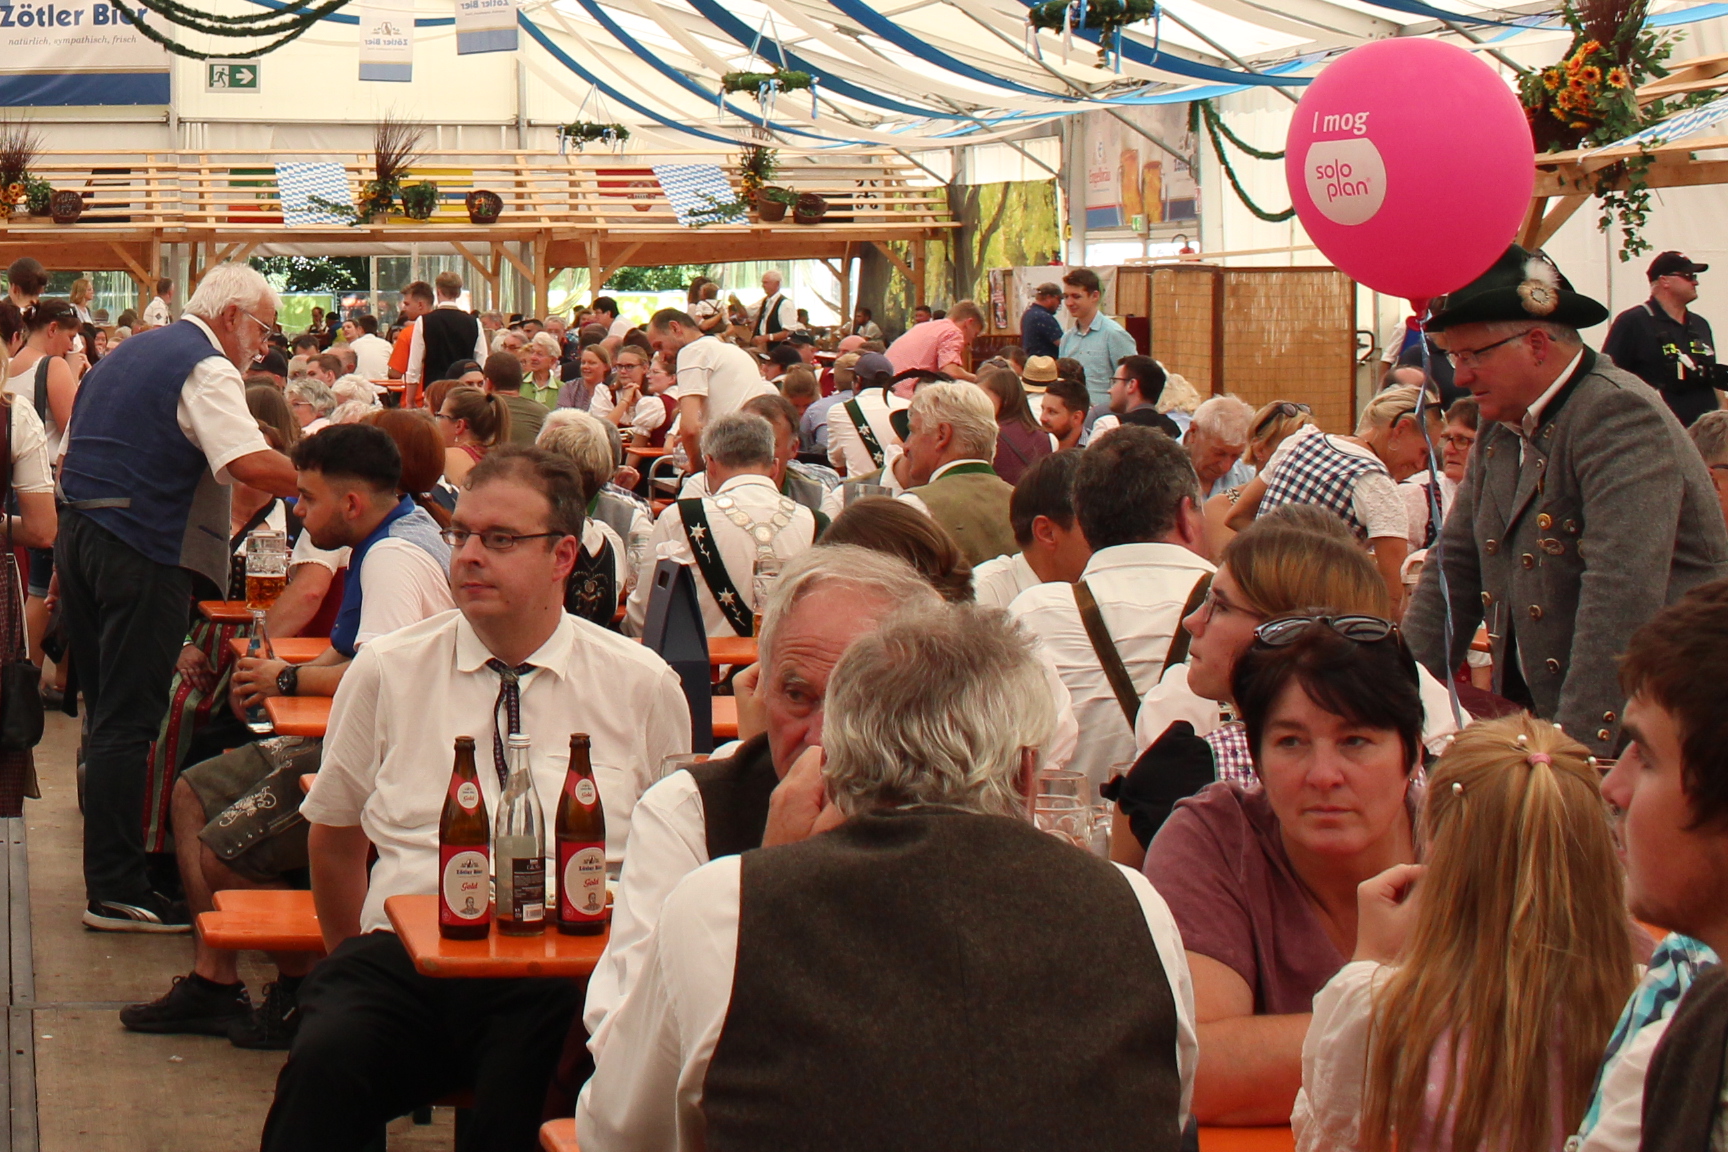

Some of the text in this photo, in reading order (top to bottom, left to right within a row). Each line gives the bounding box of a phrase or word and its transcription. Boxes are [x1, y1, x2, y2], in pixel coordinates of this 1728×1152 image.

[0, 3, 85, 28] Zötler
[8, 35, 137, 46] natürlich, sympathisch, frisch
[1312, 111, 1370, 135] I mog
[1315, 159, 1352, 180] solo
[461, 881, 478, 891] Gold
[583, 878, 600, 888] Gold
